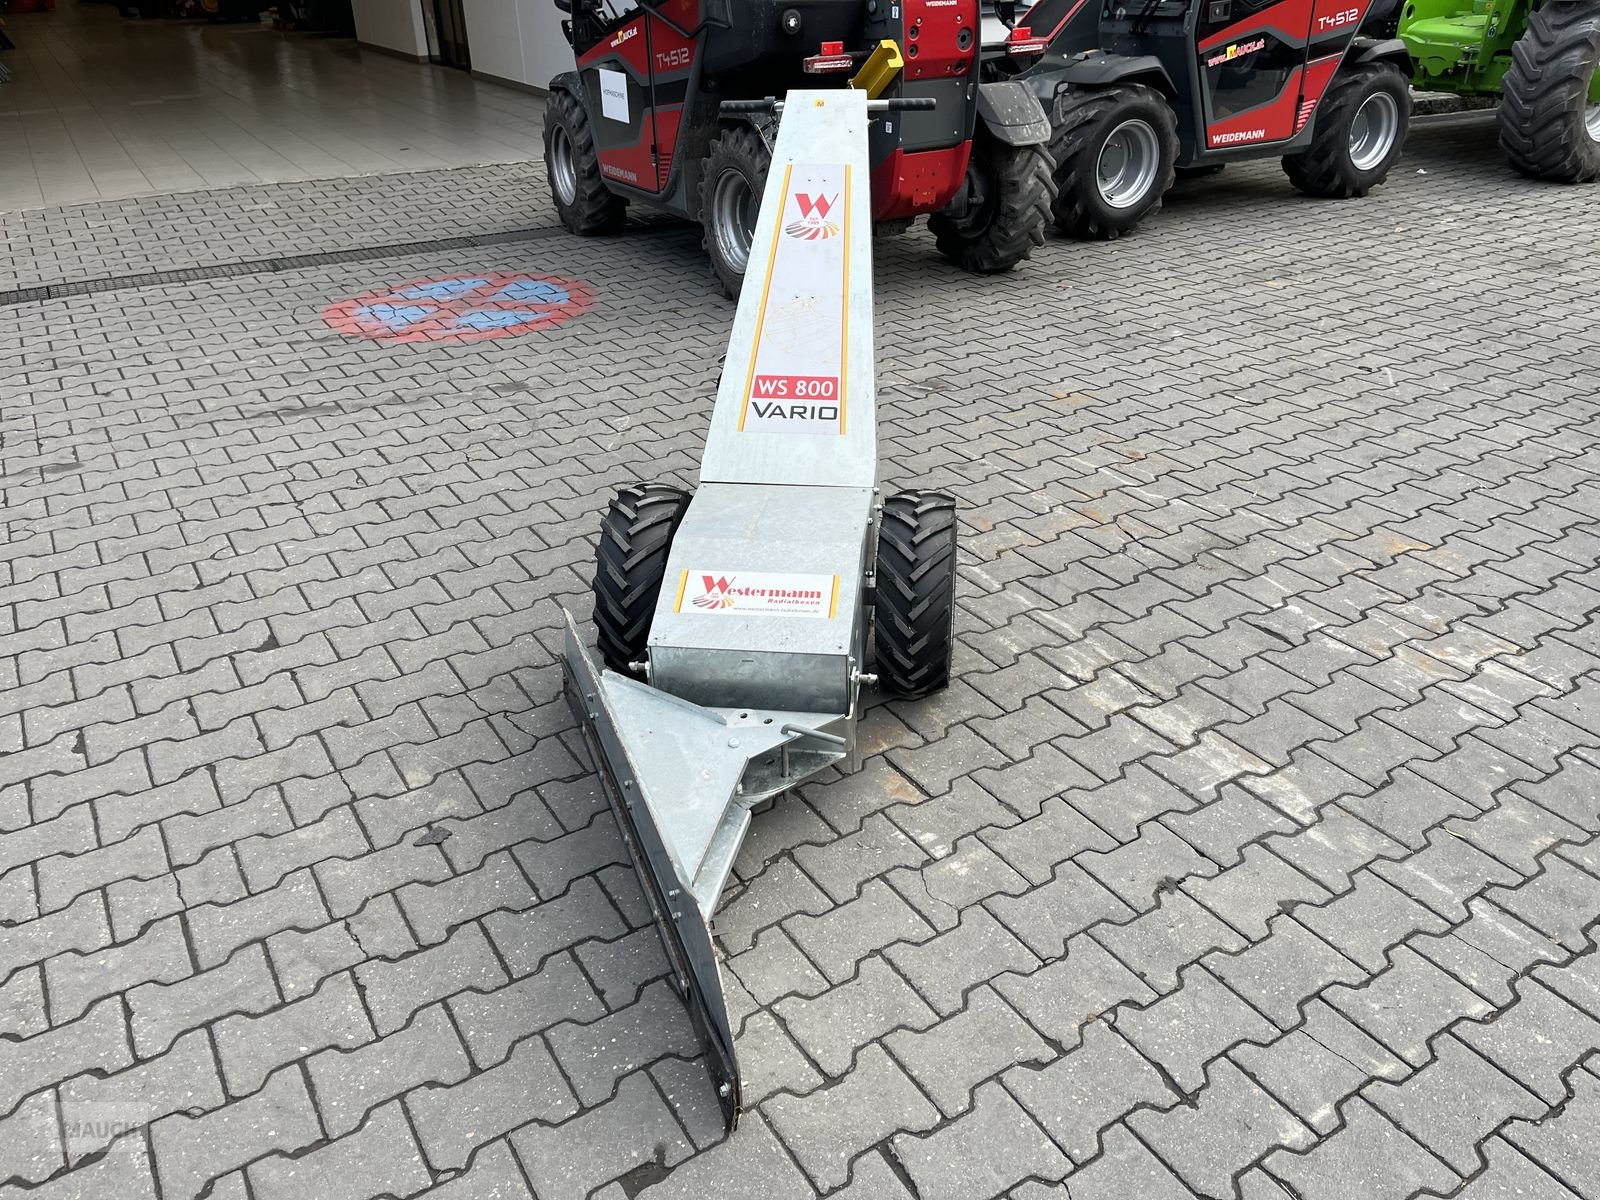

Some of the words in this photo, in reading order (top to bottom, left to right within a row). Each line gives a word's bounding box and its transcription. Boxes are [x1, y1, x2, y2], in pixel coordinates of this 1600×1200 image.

[1318, 8, 1359, 30] T4512
[656, 47, 690, 69] T4512
[1212, 129, 1265, 144] WEIDEMANN
[602, 164, 637, 182] WEIDEMANN
[758, 379, 788, 395] WS
[796, 380, 834, 397] 800
[751, 401, 838, 420] VARIO
[702, 576, 821, 598] Westermann
